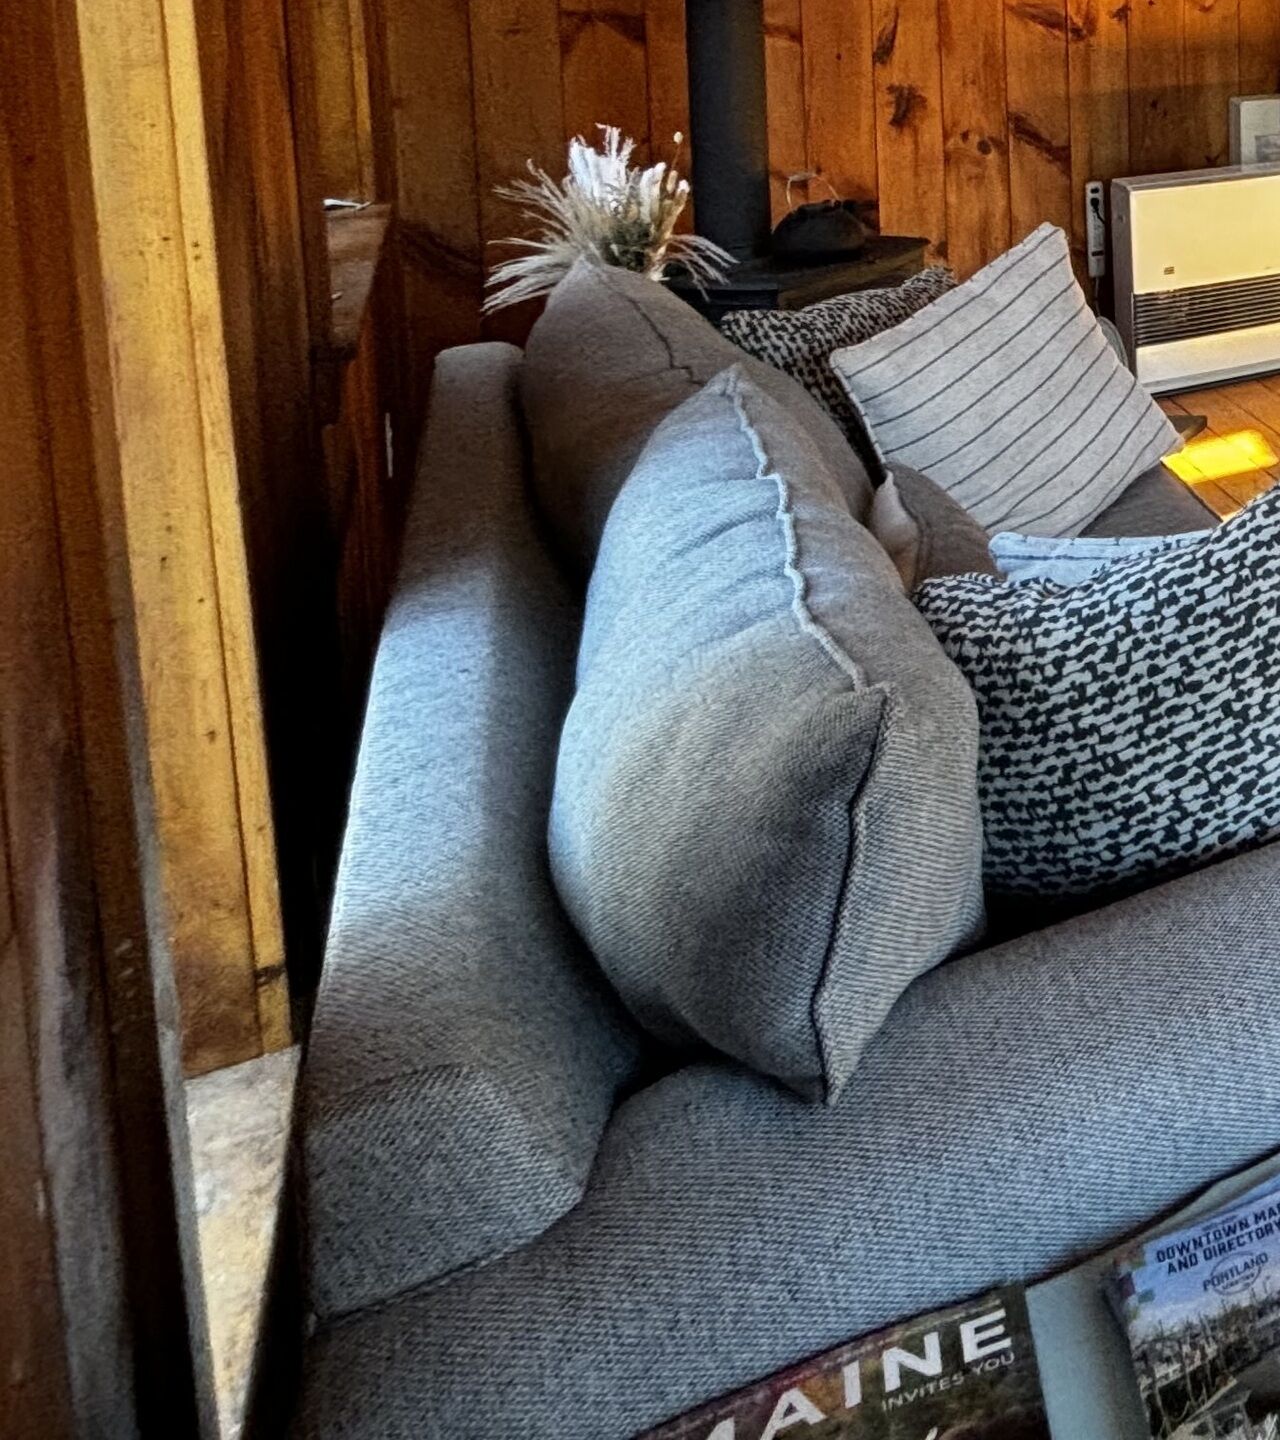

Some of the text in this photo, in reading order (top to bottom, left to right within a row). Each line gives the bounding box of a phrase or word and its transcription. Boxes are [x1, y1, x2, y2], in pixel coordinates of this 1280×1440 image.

[1156, 1217, 1251, 1264] DOWNTOWN
[1166, 1252, 1199, 1276] AND
[1202, 1252, 1269, 1292] PORTLAND
[881, 1350, 1016, 1413] INVITES YOU
